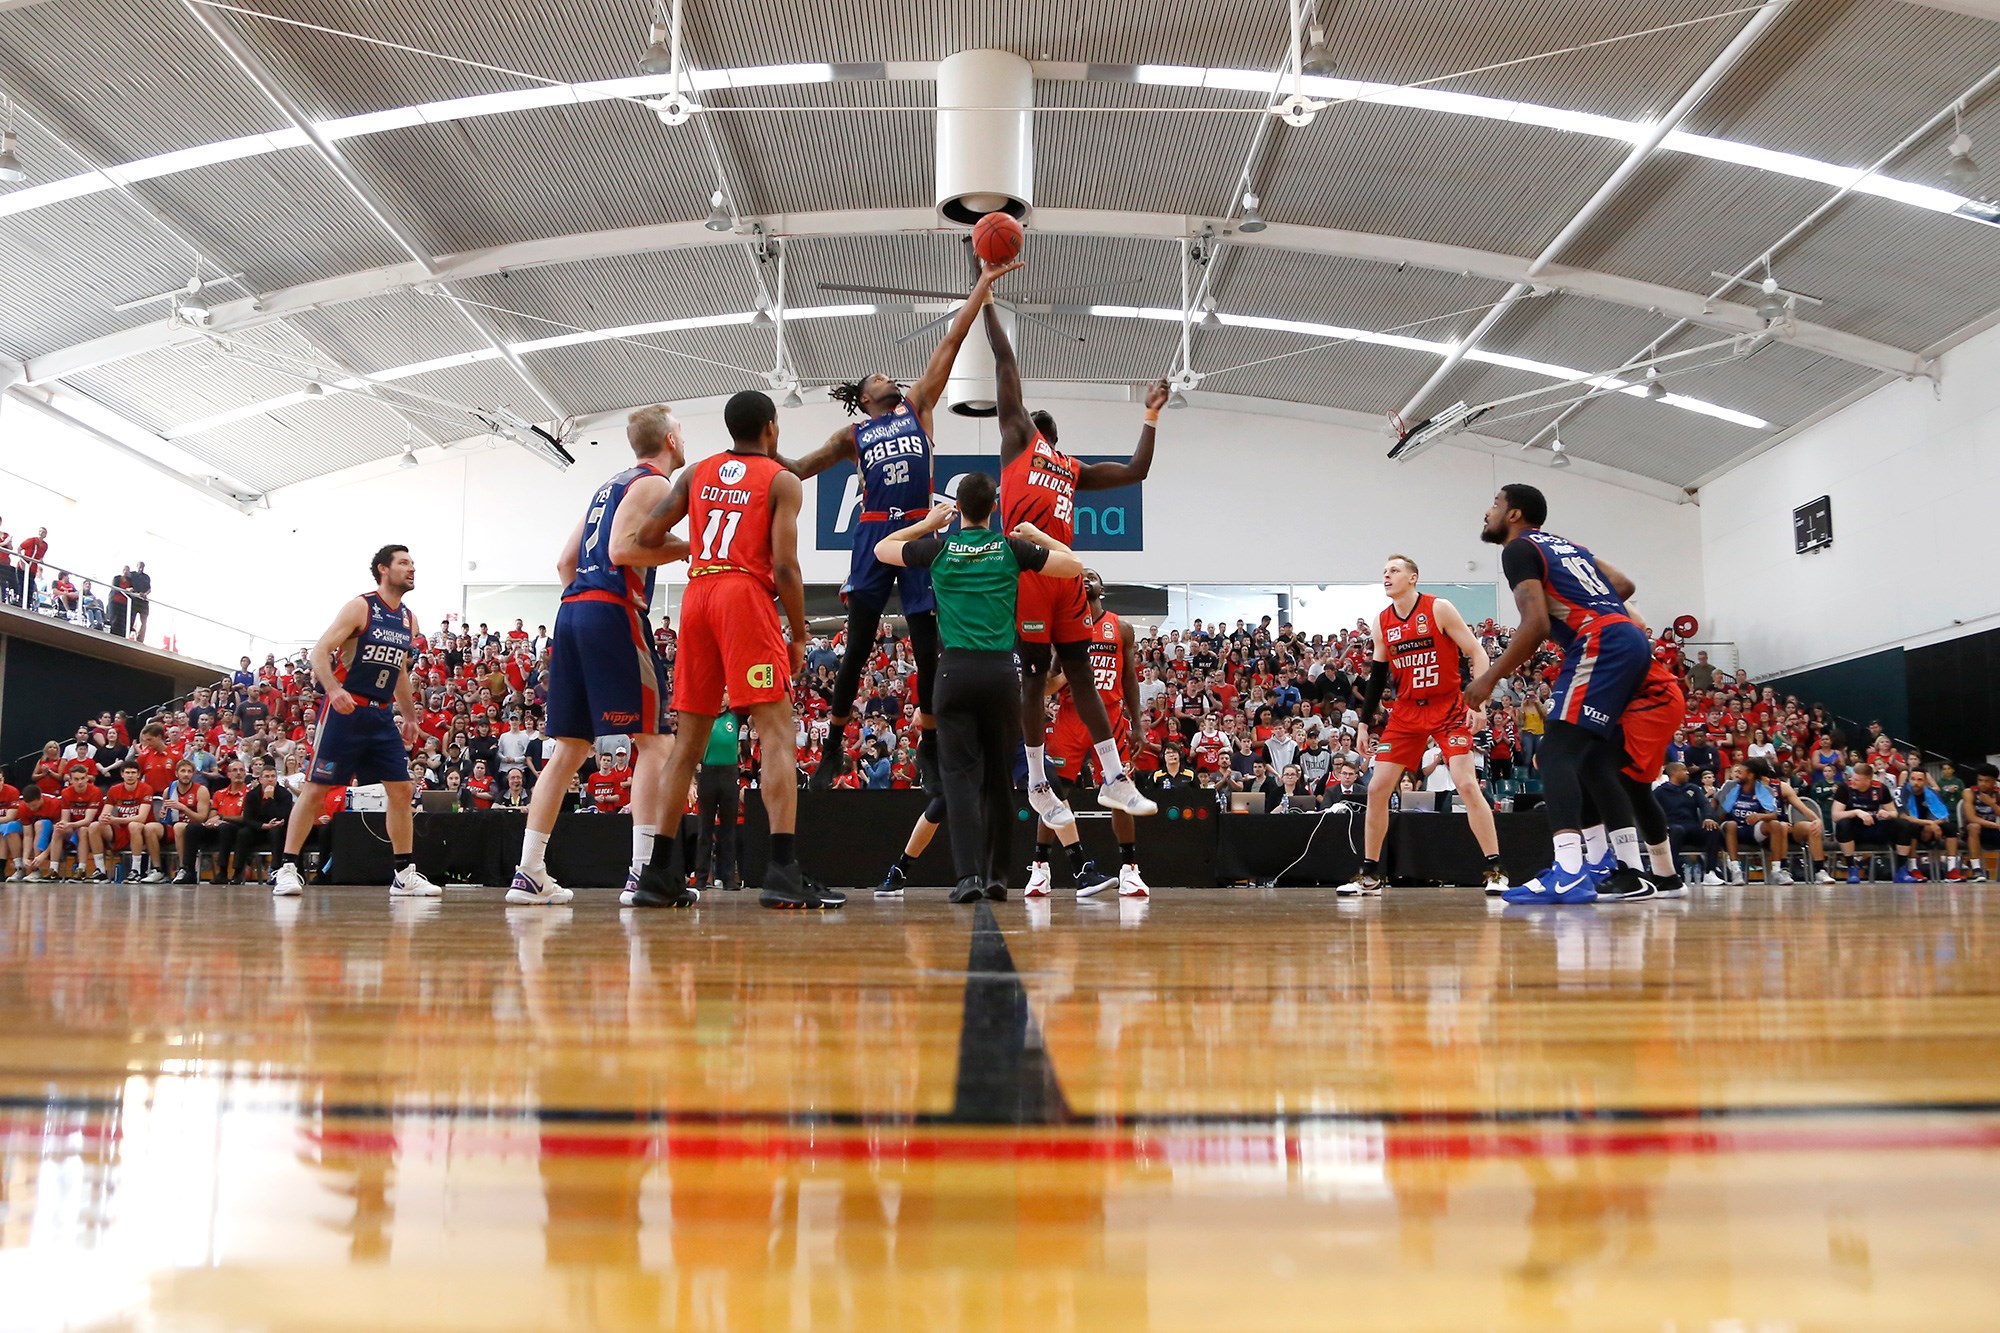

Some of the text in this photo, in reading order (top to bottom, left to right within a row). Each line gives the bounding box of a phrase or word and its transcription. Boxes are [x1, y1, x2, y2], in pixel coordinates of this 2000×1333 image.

[864, 436, 923, 469] 36ERS
[720, 466, 738, 478] hif
[882, 460, 910, 486] 32
[700, 485, 752, 505] COTTON
[1028, 470, 1073, 499] WILDCA
[585, 503, 607, 558] 7
[699, 508, 742, 561] 11
[948, 541, 1004, 555] Europcar
[1561, 556, 1609, 596] 10
[362, 644, 403, 668] 36ER
[1398, 640, 1432, 651] PENTANET
[375, 669, 390, 689] 8
[1094, 669, 1117, 691] 23
[1413, 665, 1439, 689] 25
[601, 711, 640, 722] Nippy's
